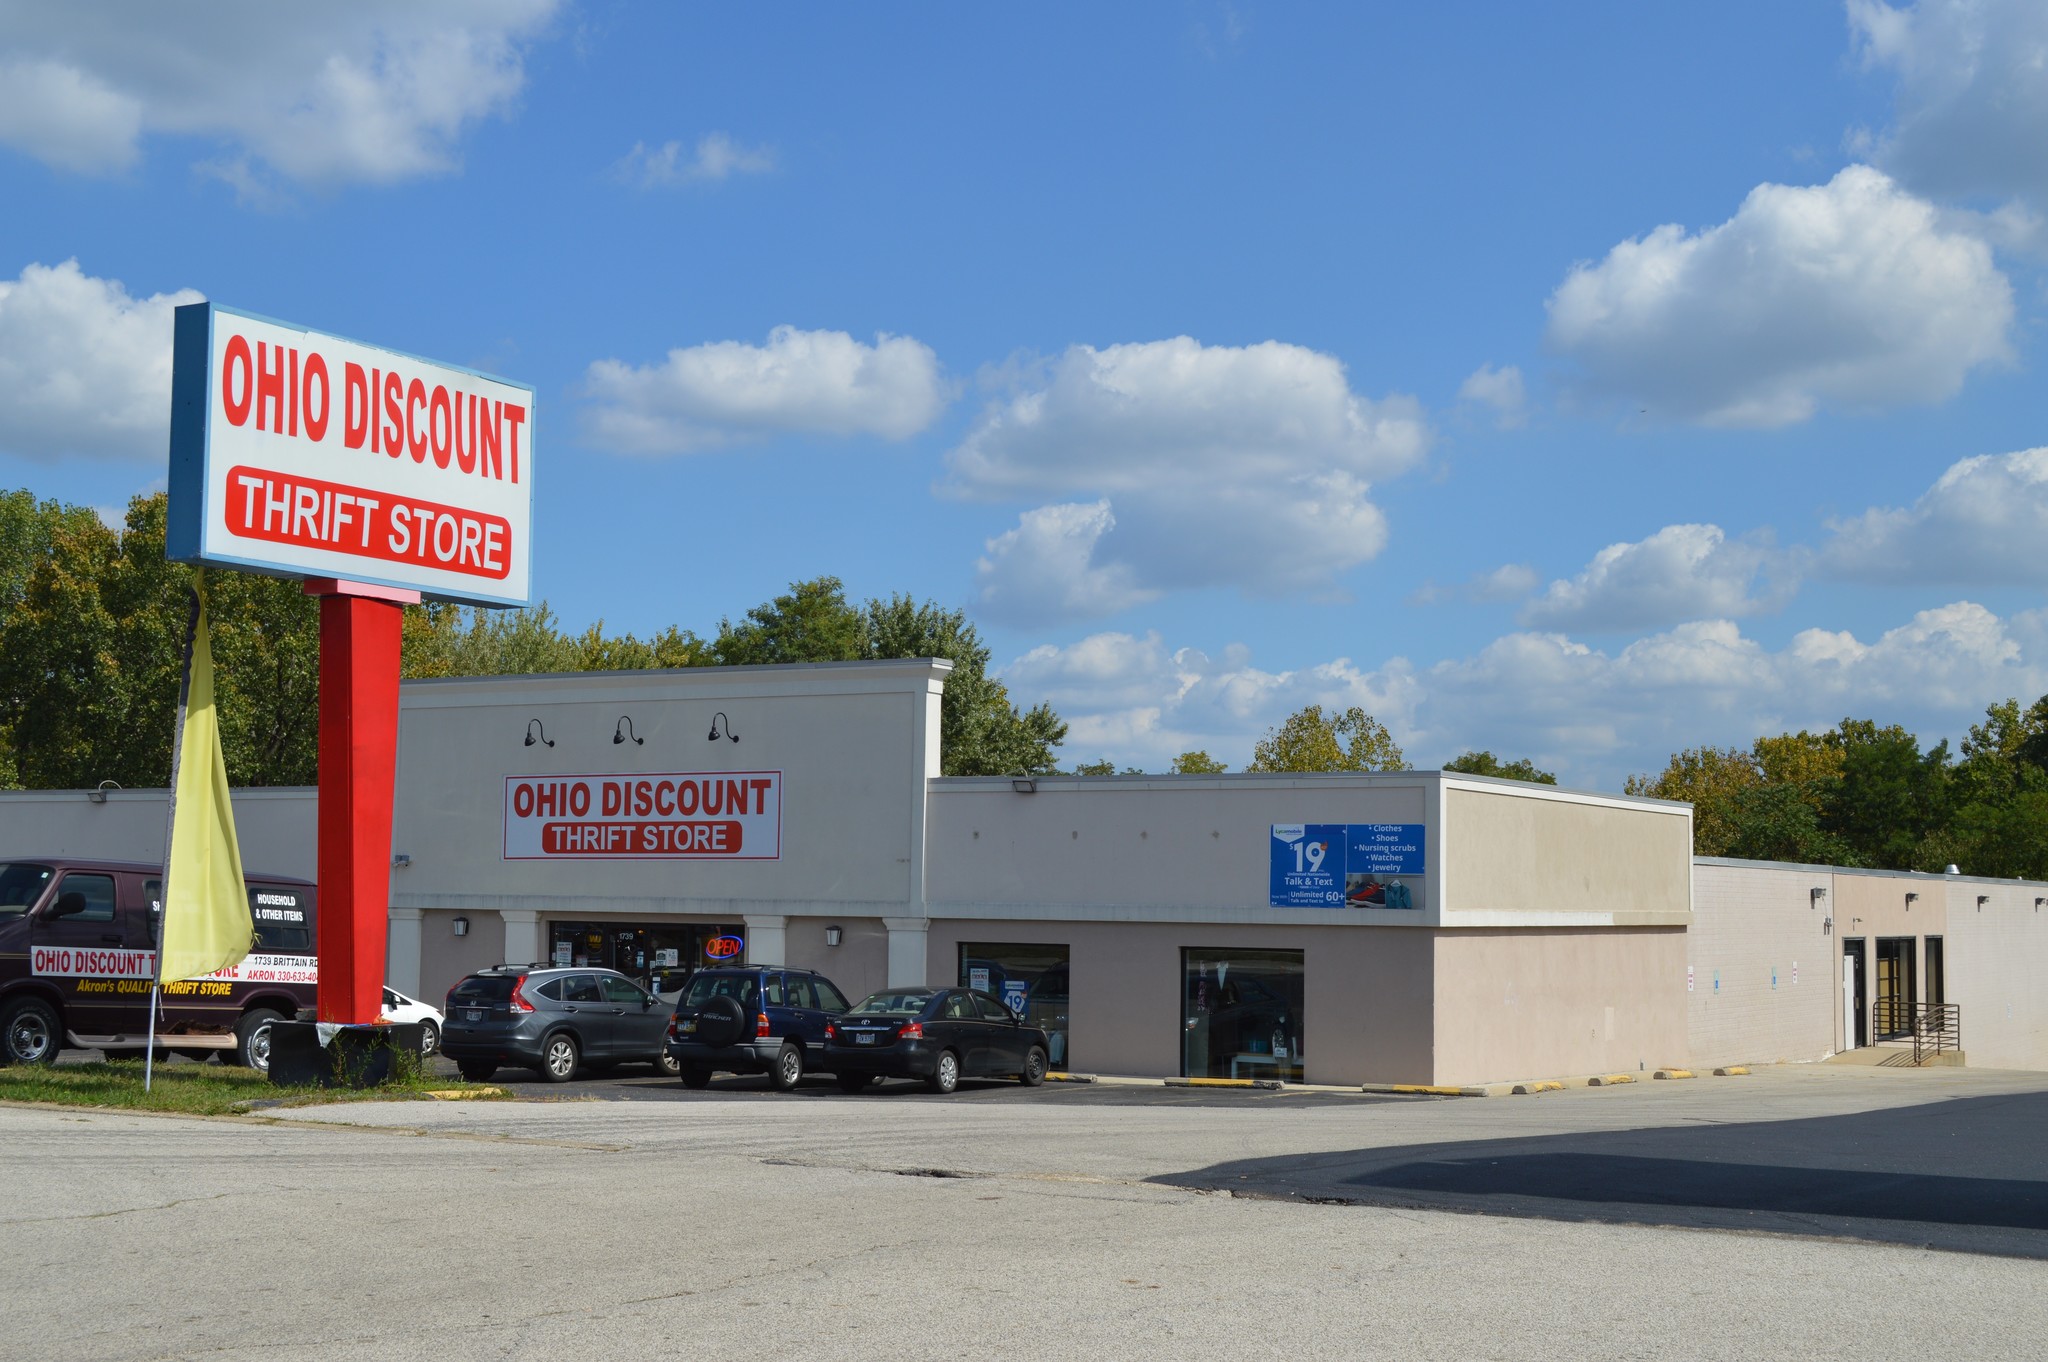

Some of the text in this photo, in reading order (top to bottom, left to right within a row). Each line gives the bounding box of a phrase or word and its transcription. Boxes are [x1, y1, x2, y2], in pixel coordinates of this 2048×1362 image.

[222, 334, 526, 484] OHIO DISCOUNT
[238, 475, 504, 571] THRIFT STORE
[514, 779, 771, 818] OHIO DISCOUNT
[551, 825, 727, 850] THRIFT STORE
[1359, 844, 1389, 853] Nursing
[1372, 864, 1401, 872] Jewelry
[1285, 877, 1333, 886] Talk & Text
[257, 894, 296, 907] HOUSEHOLD
[1326, 891, 1345, 901] 60+
[256, 908, 303, 922] & OTHER ITEMS
[619, 932, 634, 941] 1739
[707, 939, 739, 955] OPEN
[35, 949, 71, 973] OHIO
[75, 951, 145, 975] DISCOUNT
[254, 956, 272, 966] 1739
[273, 957, 307, 968] BRITTAIN
[247, 970, 275, 981] AKRON
[277, 971, 318, 983] 330-633-40
[77, 979, 232, 996] Akron's QUALIT THRIFT STORE
[1008, 995, 1022, 1010] 19
[703, 1013, 732, 1022] TRACKER
